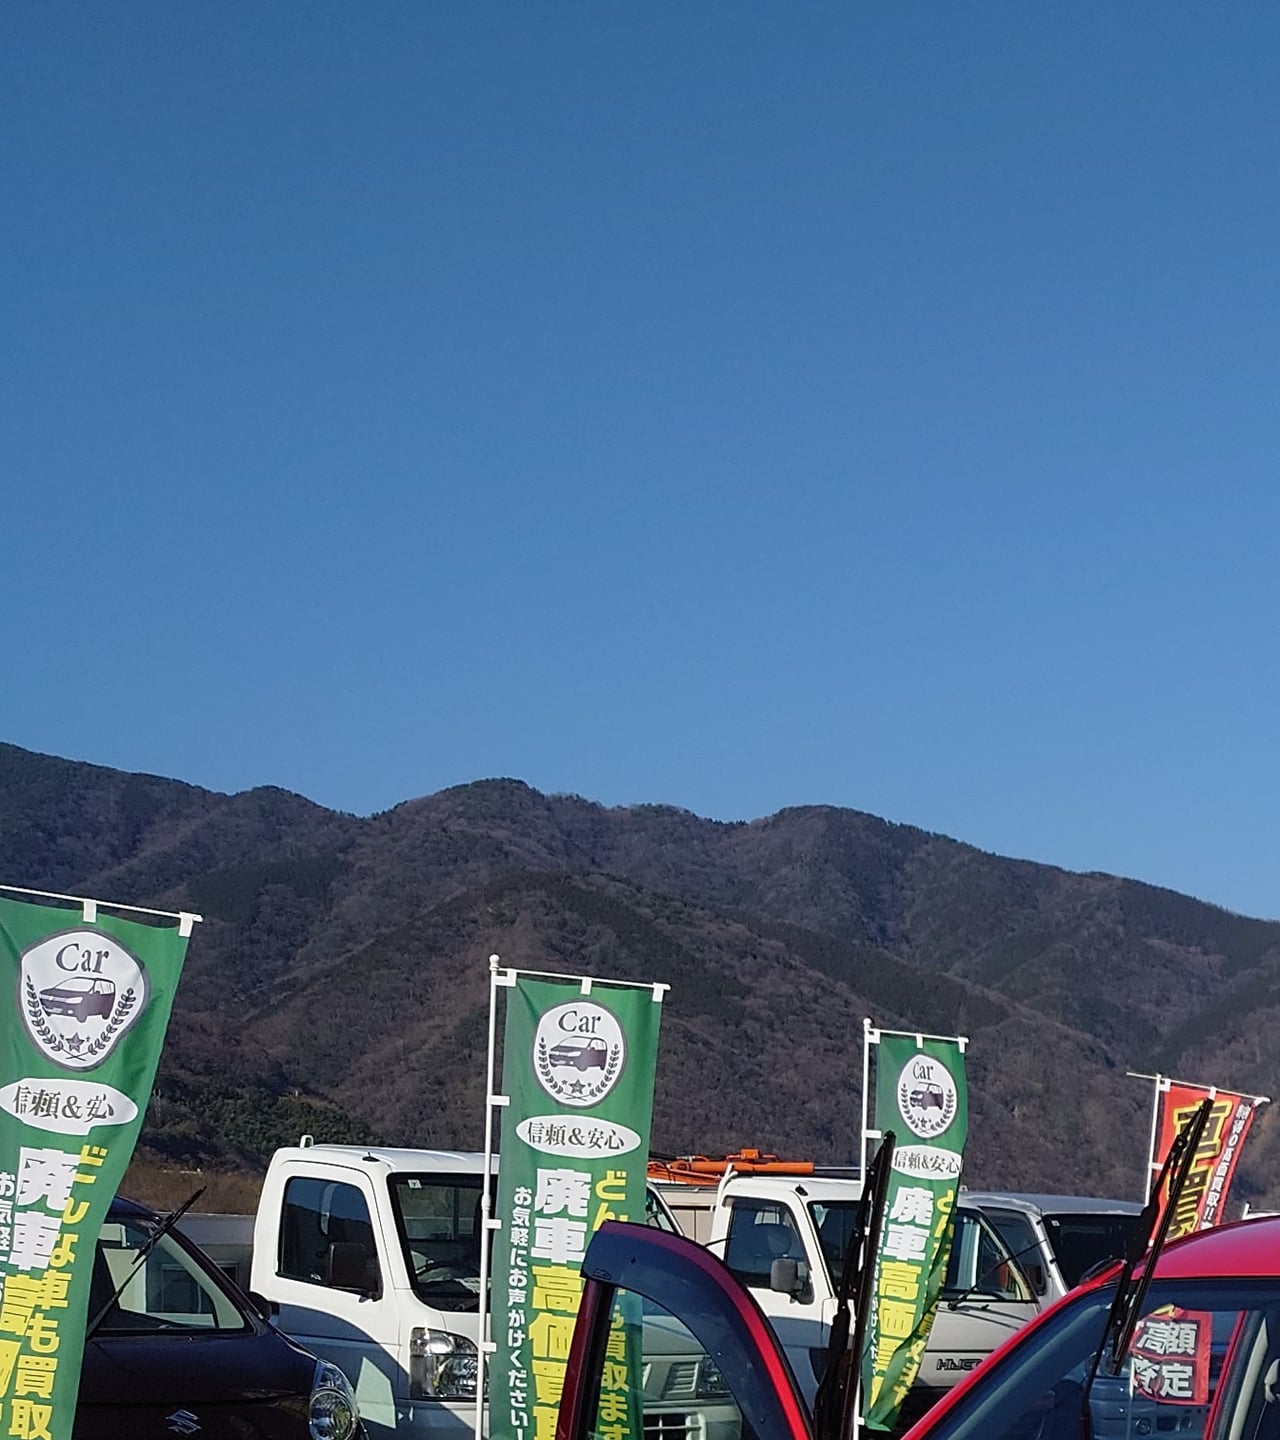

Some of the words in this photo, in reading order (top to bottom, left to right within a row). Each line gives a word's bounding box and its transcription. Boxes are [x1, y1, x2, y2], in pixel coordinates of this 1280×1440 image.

[56, 943, 109, 974] Car
[558, 1010, 601, 1034] Car
[912, 1061, 933, 1080] Car
[527, 1122, 625, 1150] 信頼&安心
